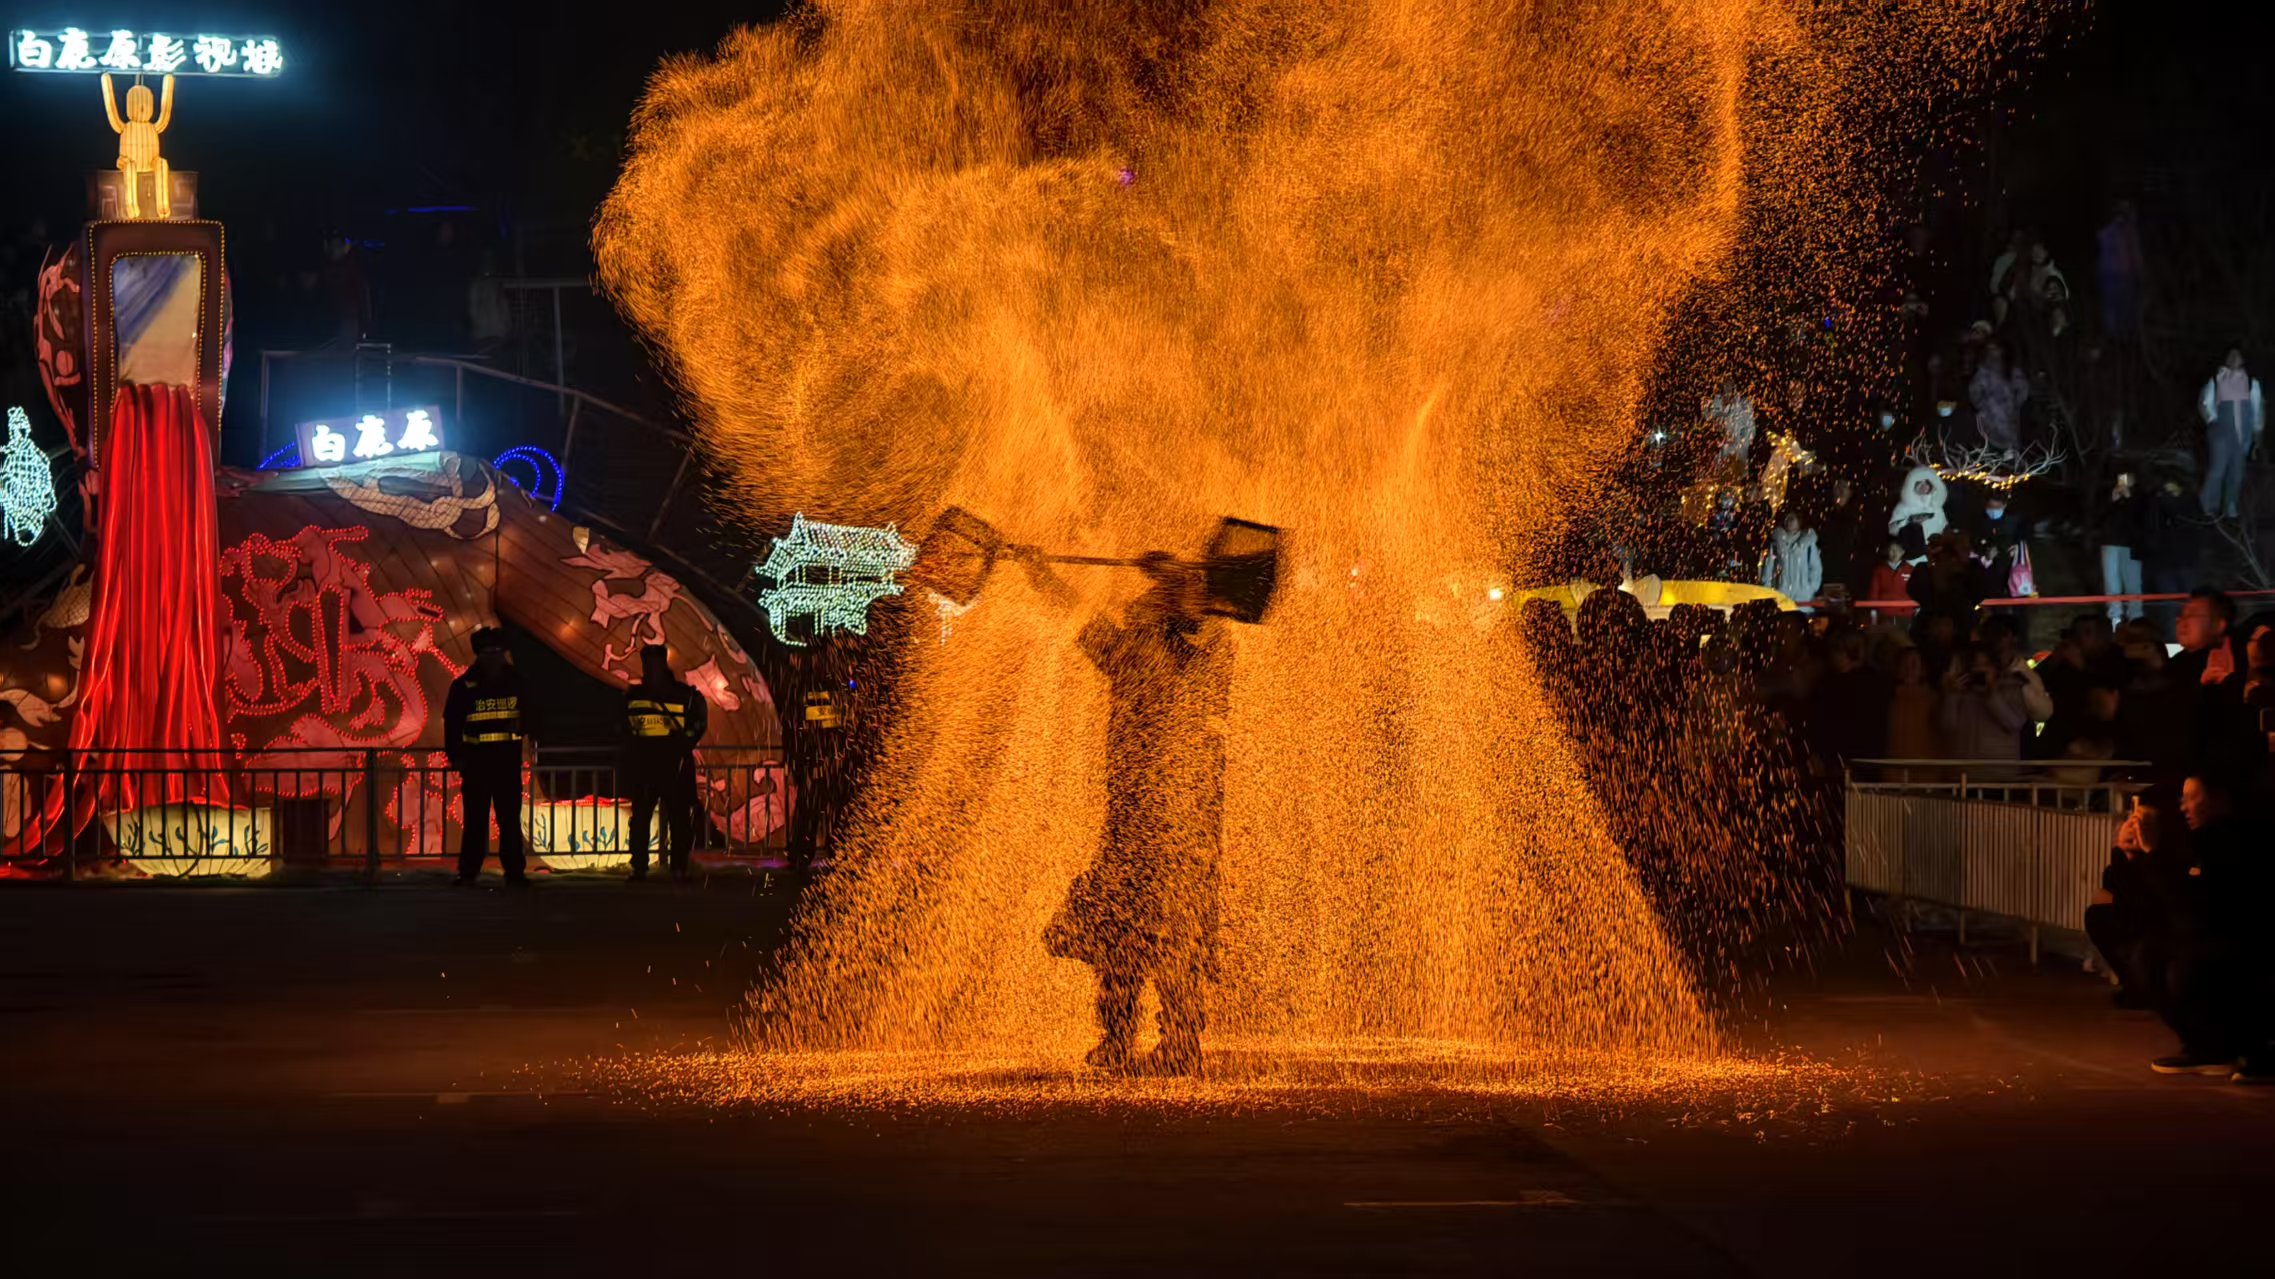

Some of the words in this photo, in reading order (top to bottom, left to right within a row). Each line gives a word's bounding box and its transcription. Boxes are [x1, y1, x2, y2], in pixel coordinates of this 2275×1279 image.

[18, 27, 283, 74] 白鹿原影视城
[312, 409, 439, 462] 白鹿原
[475, 696, 518, 712] 治安巡逻
